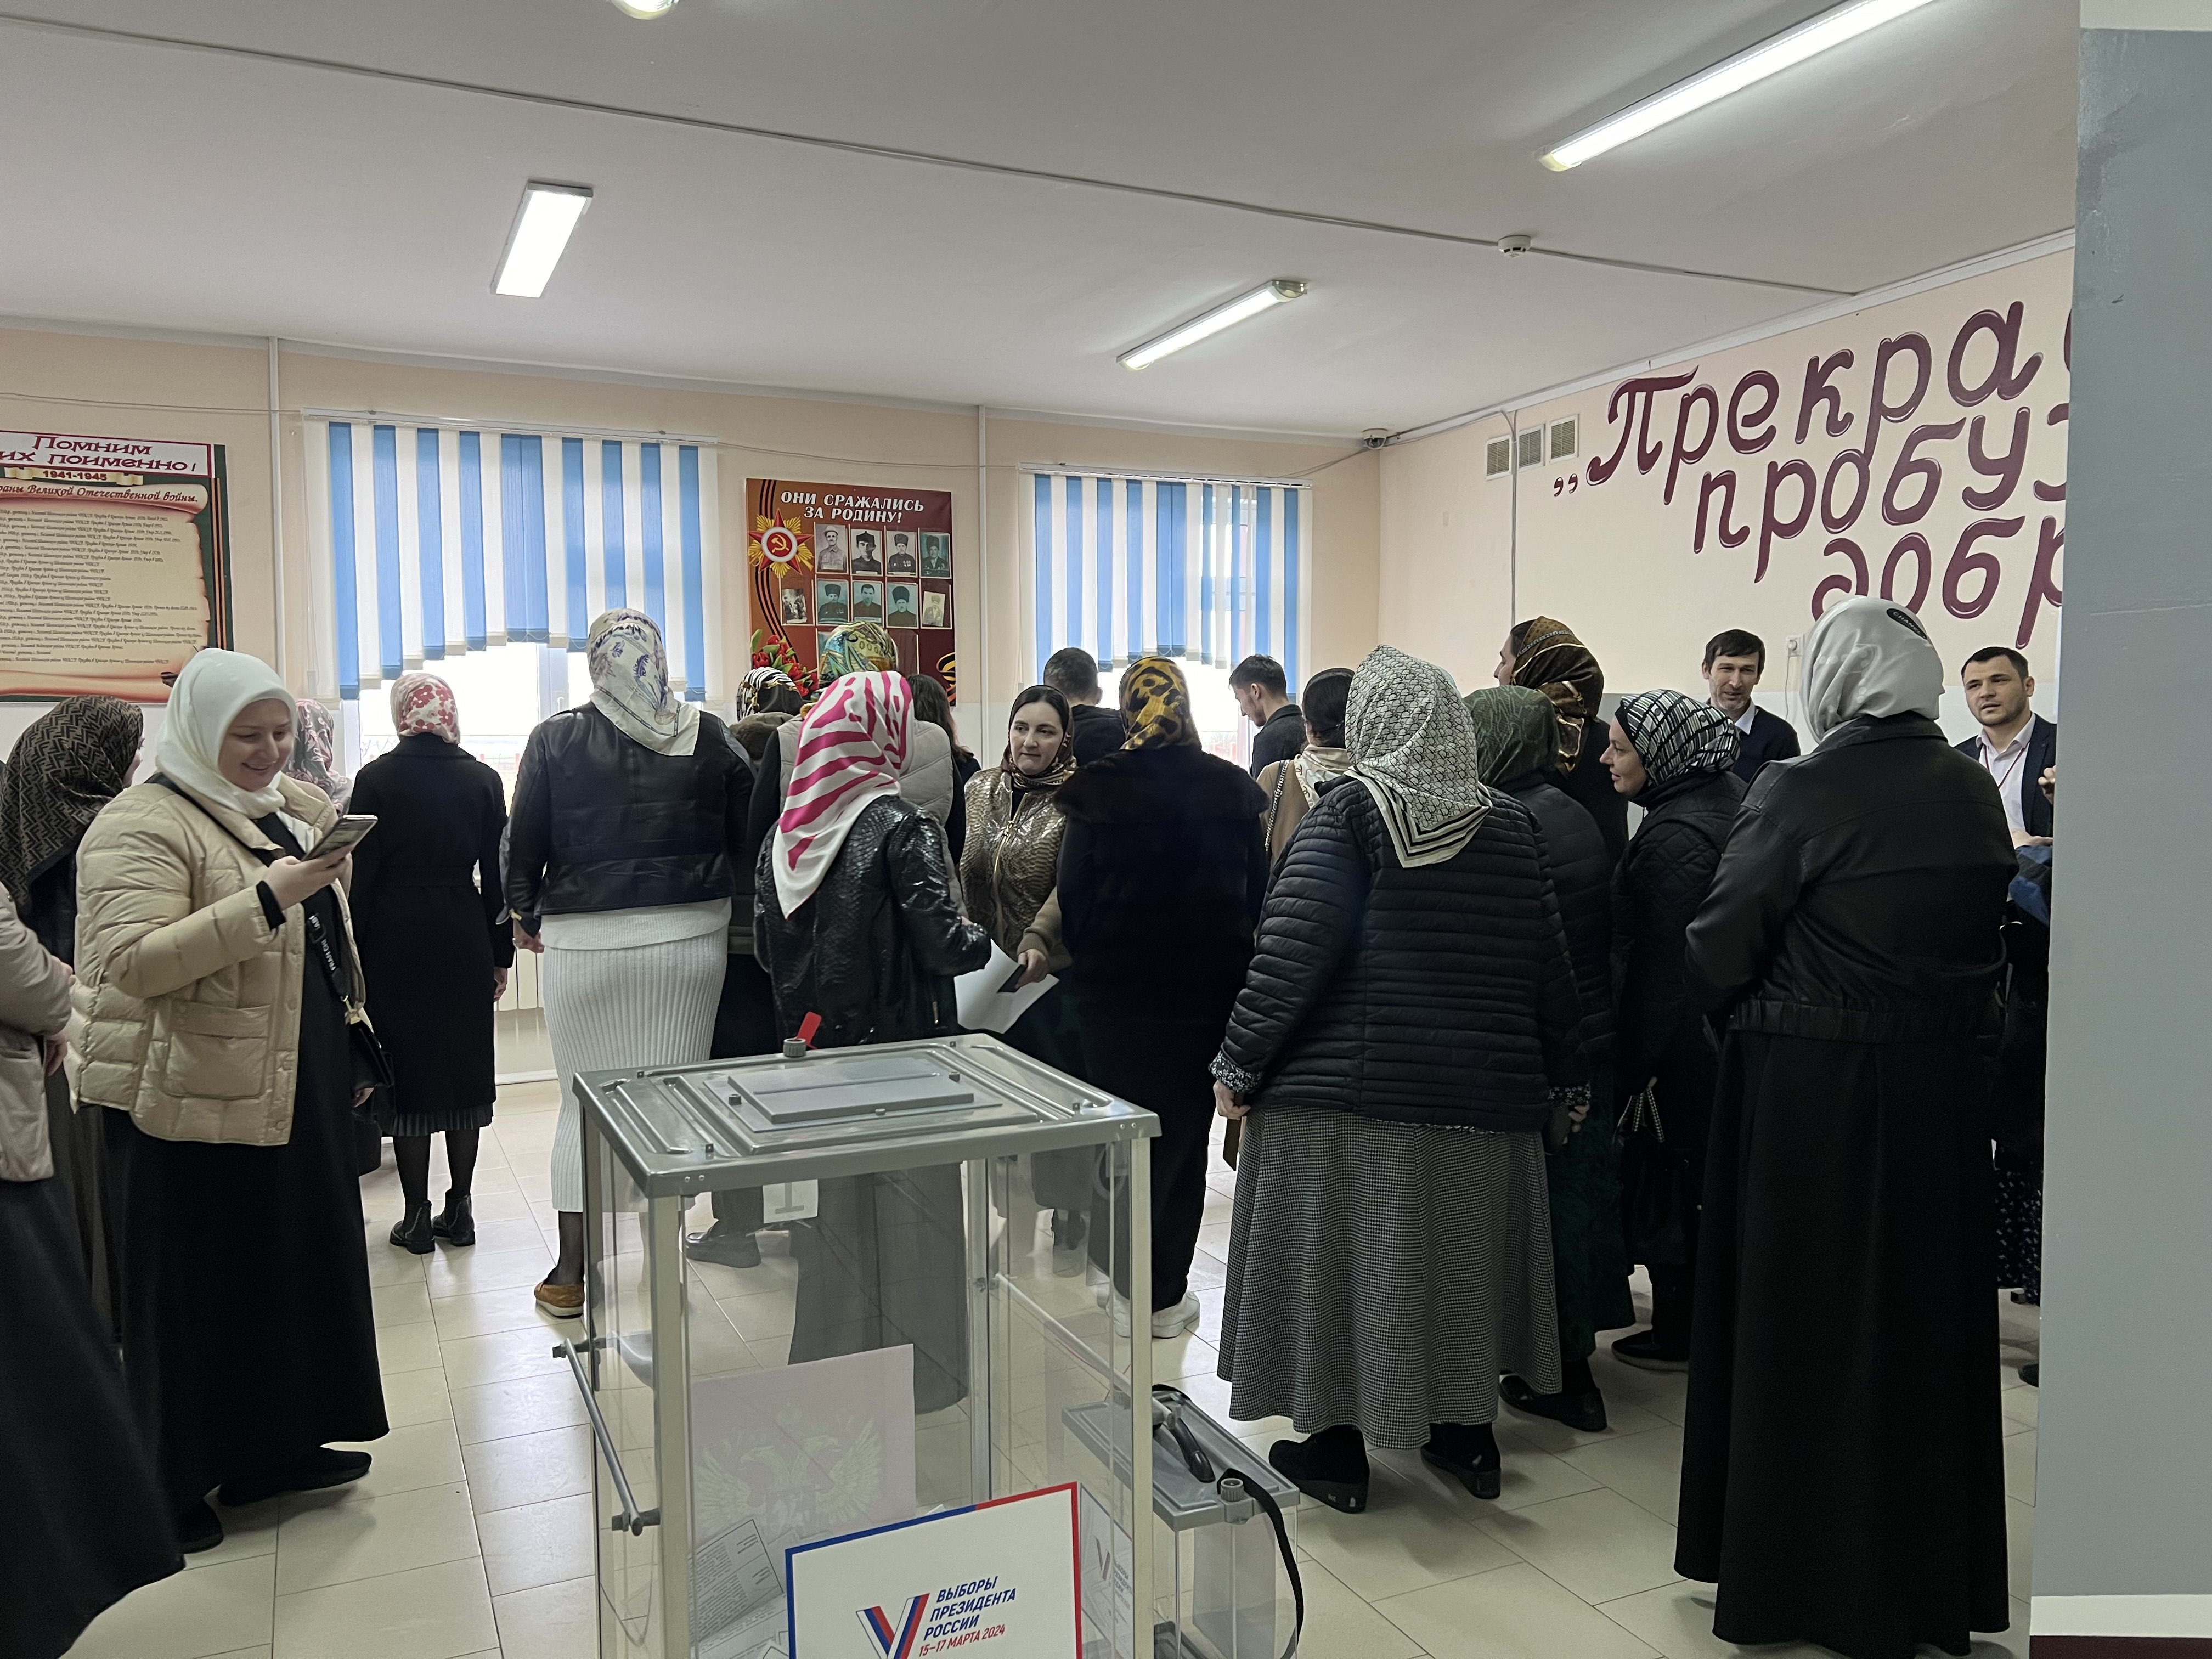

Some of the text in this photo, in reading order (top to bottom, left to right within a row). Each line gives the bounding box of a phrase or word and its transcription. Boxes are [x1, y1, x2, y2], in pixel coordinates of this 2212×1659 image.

[43, 470, 107, 481] 1941-1945
[27, 484, 74, 496] Великой
[77, 487, 160, 500] Отечественной
[163, 491, 198, 502] войны.
[781, 491, 924, 511] ОНИ СРАЖАЛИСЬ
[804, 506, 902, 523] ЗА РОДИНУ!
[936, 1576, 998, 1603] ВЫБОРЫ
[930, 1588, 1016, 1622] ПРЕЗИДЕНТА
[923, 1614, 980, 1641] РОССИИ
[947, 1630, 980, 1649] МАРТА
[982, 1624, 1005, 1640] 2024
